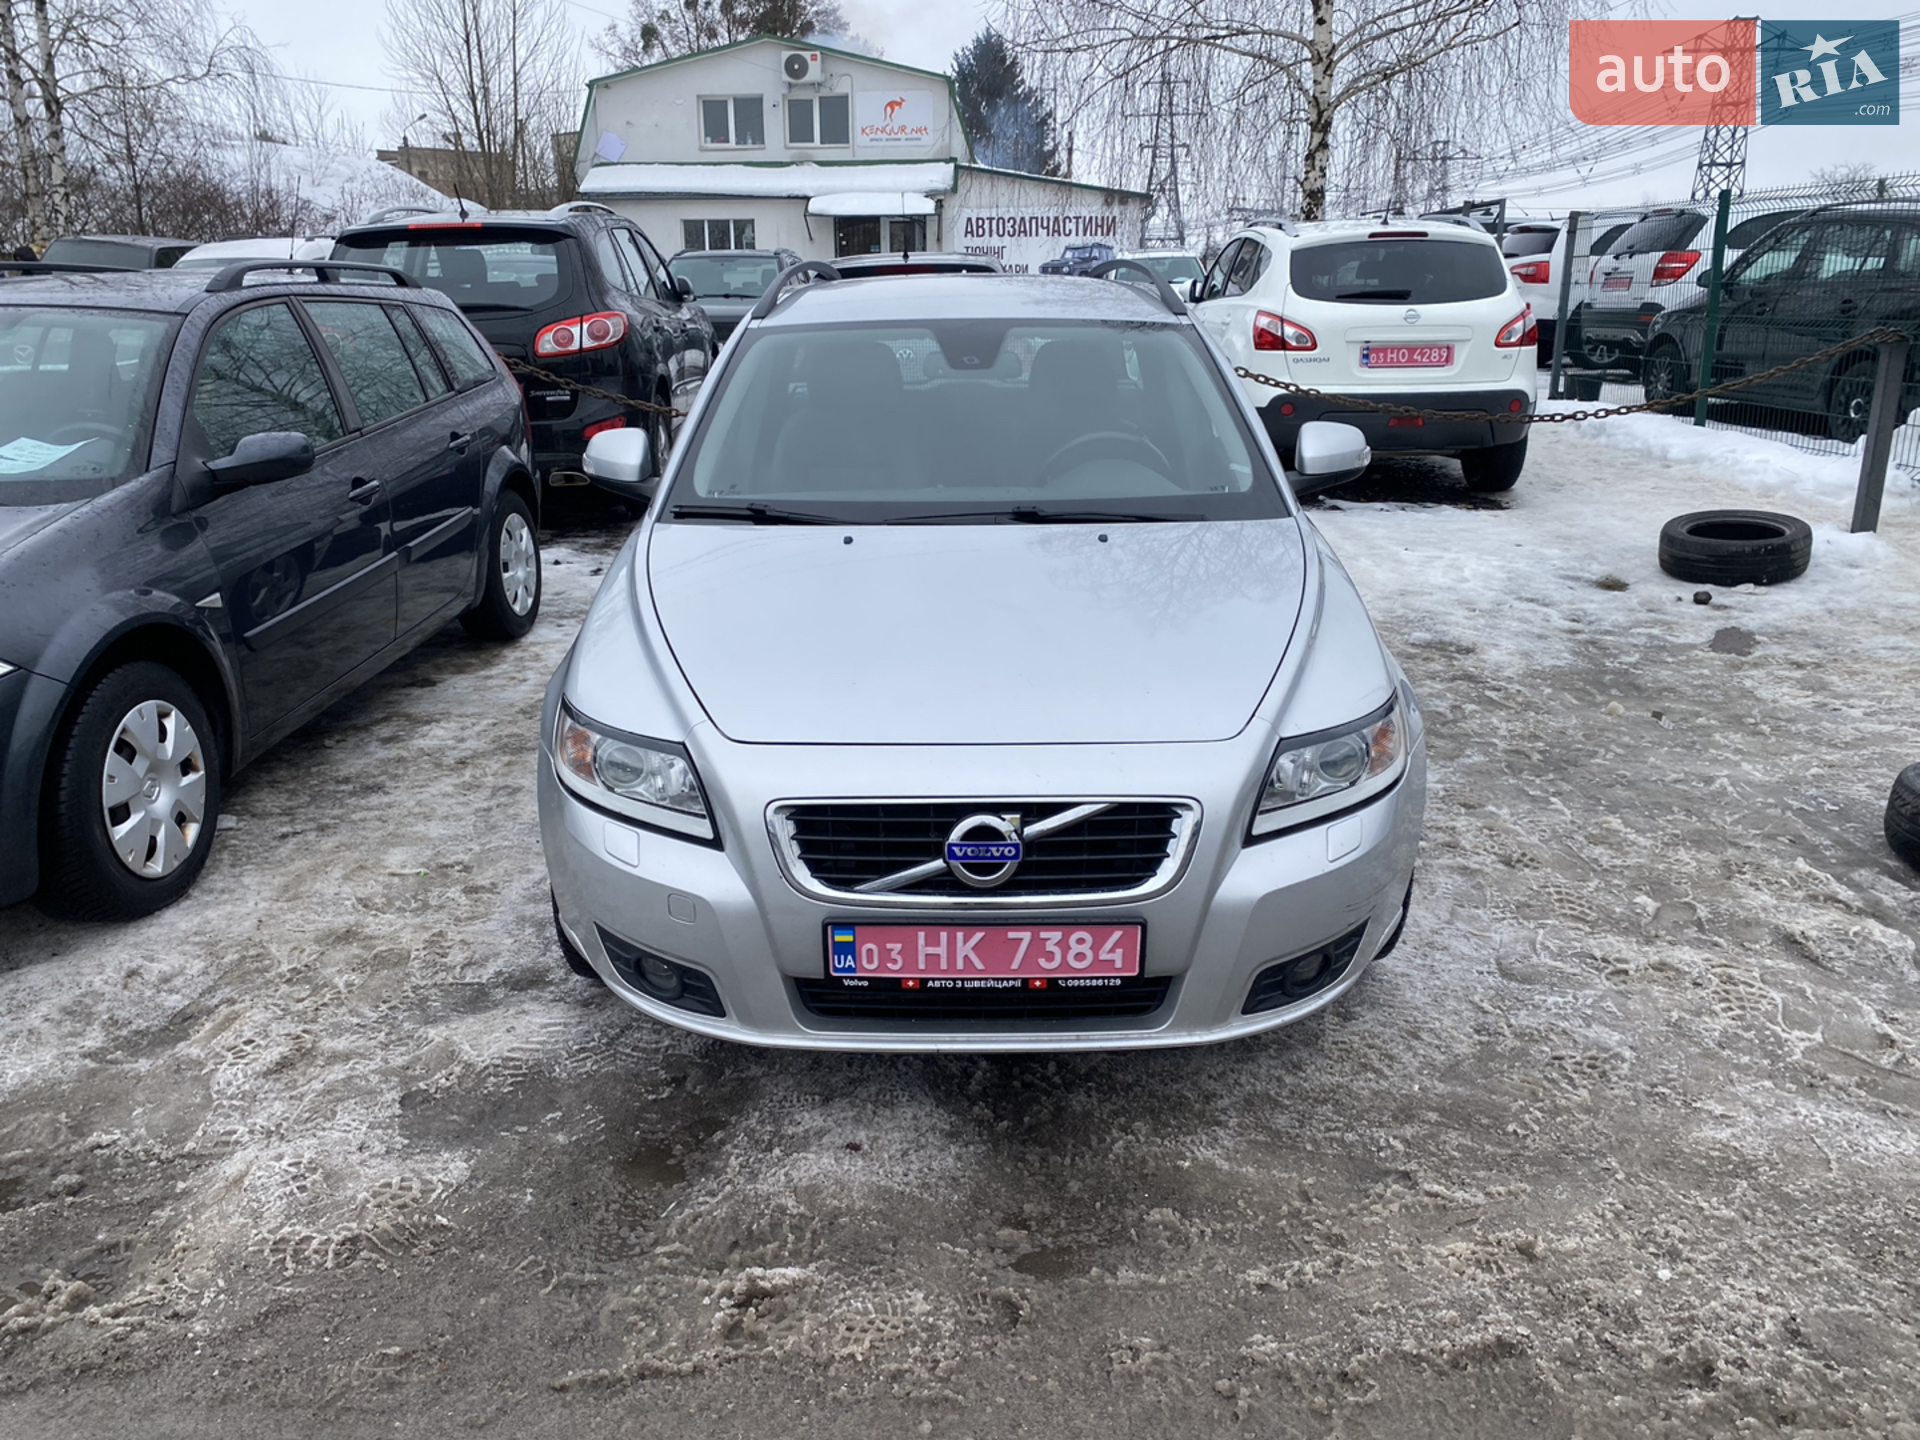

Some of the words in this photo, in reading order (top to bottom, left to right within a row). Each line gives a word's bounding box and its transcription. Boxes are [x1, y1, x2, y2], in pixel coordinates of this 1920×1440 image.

[963, 216, 1117, 238] АВТОЗАПЧАСТИНИ
[1370, 353, 1384, 363] 03
[1413, 348, 1448, 362] 4289
[951, 846, 1017, 857] VOLVO
[834, 954, 856, 968] UA
[860, 943, 904, 971] 03
[917, 931, 986, 971] HK
[1007, 931, 1124, 971] 7384
[843, 979, 869, 987] Volvo
[927, 980, 954, 988] АВТО
[964, 978, 1022, 989] ШВЕЙЦАРІЇ
